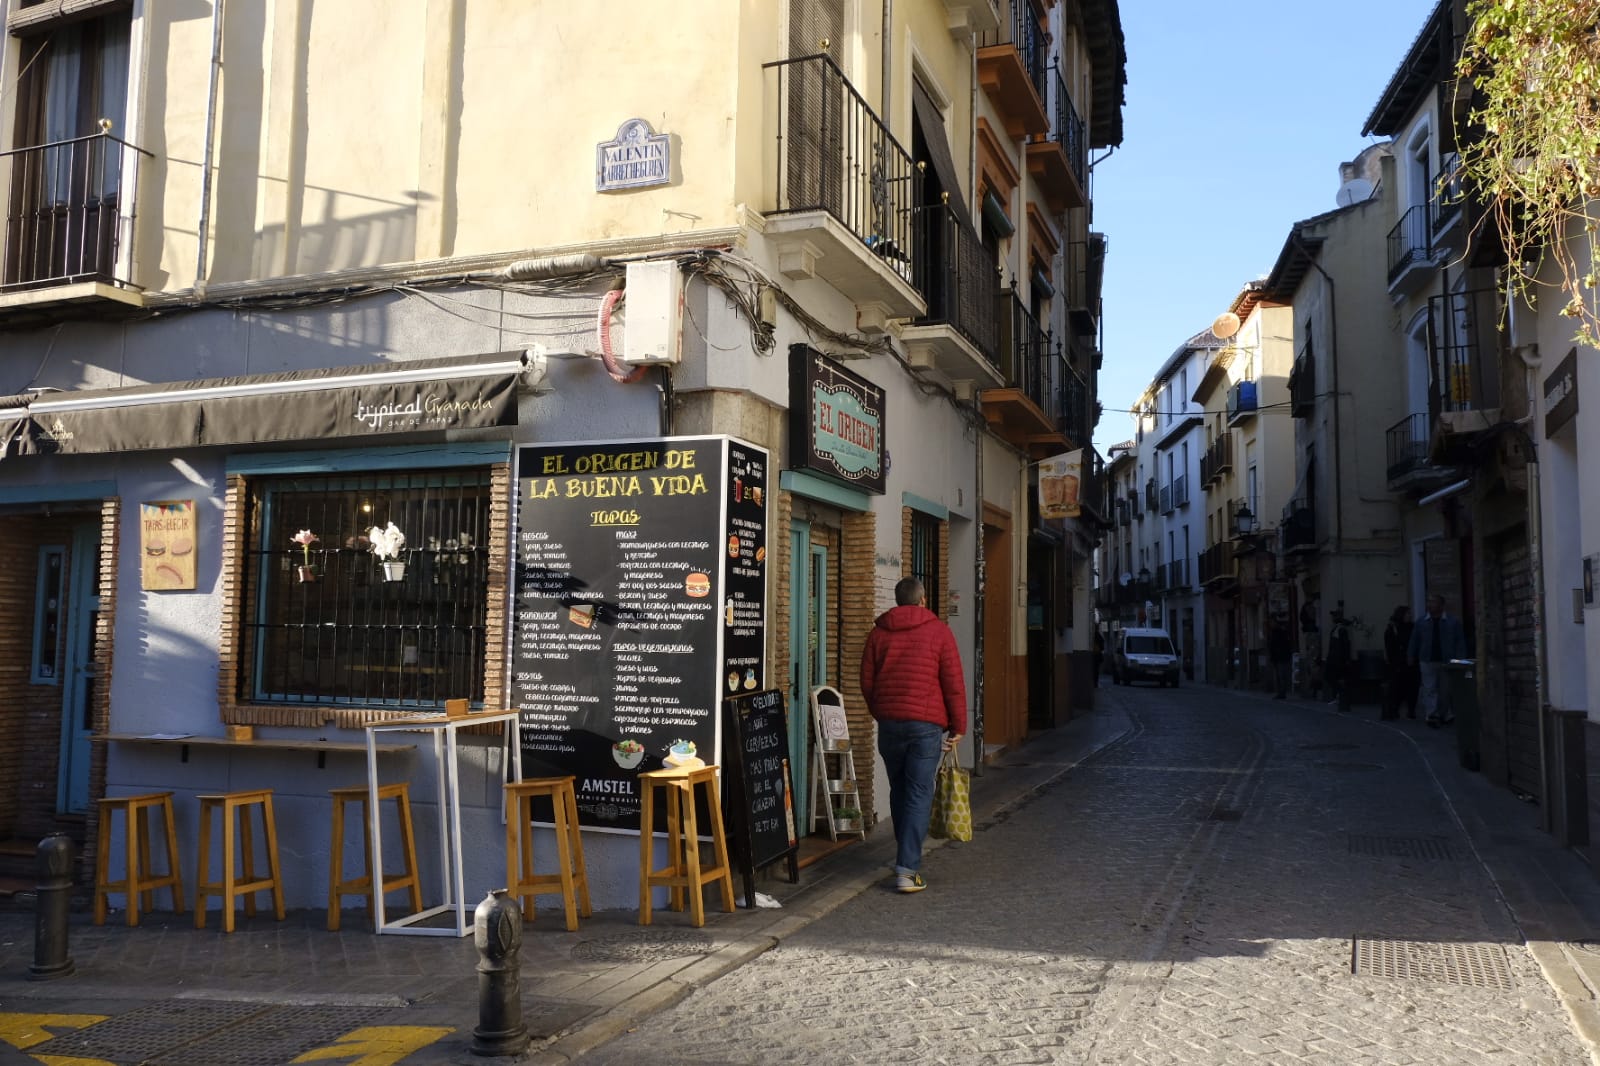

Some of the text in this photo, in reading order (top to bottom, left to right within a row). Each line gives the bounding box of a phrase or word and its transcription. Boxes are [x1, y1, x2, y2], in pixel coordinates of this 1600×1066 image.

[604, 144, 662, 162] VALENTIN
[354, 392, 493, 428] typical Granada
[820, 402, 834, 434] EL
[838, 410, 876, 452] ORIGEN
[543, 450, 696, 474] EL ORIGEN DE
[530, 474, 708, 499] LA BUENA VIDA
[590, 510, 640, 525] TAPAS
[746, 732, 779, 752] CERVEZAS
[582, 779, 634, 795] AMSTEL
